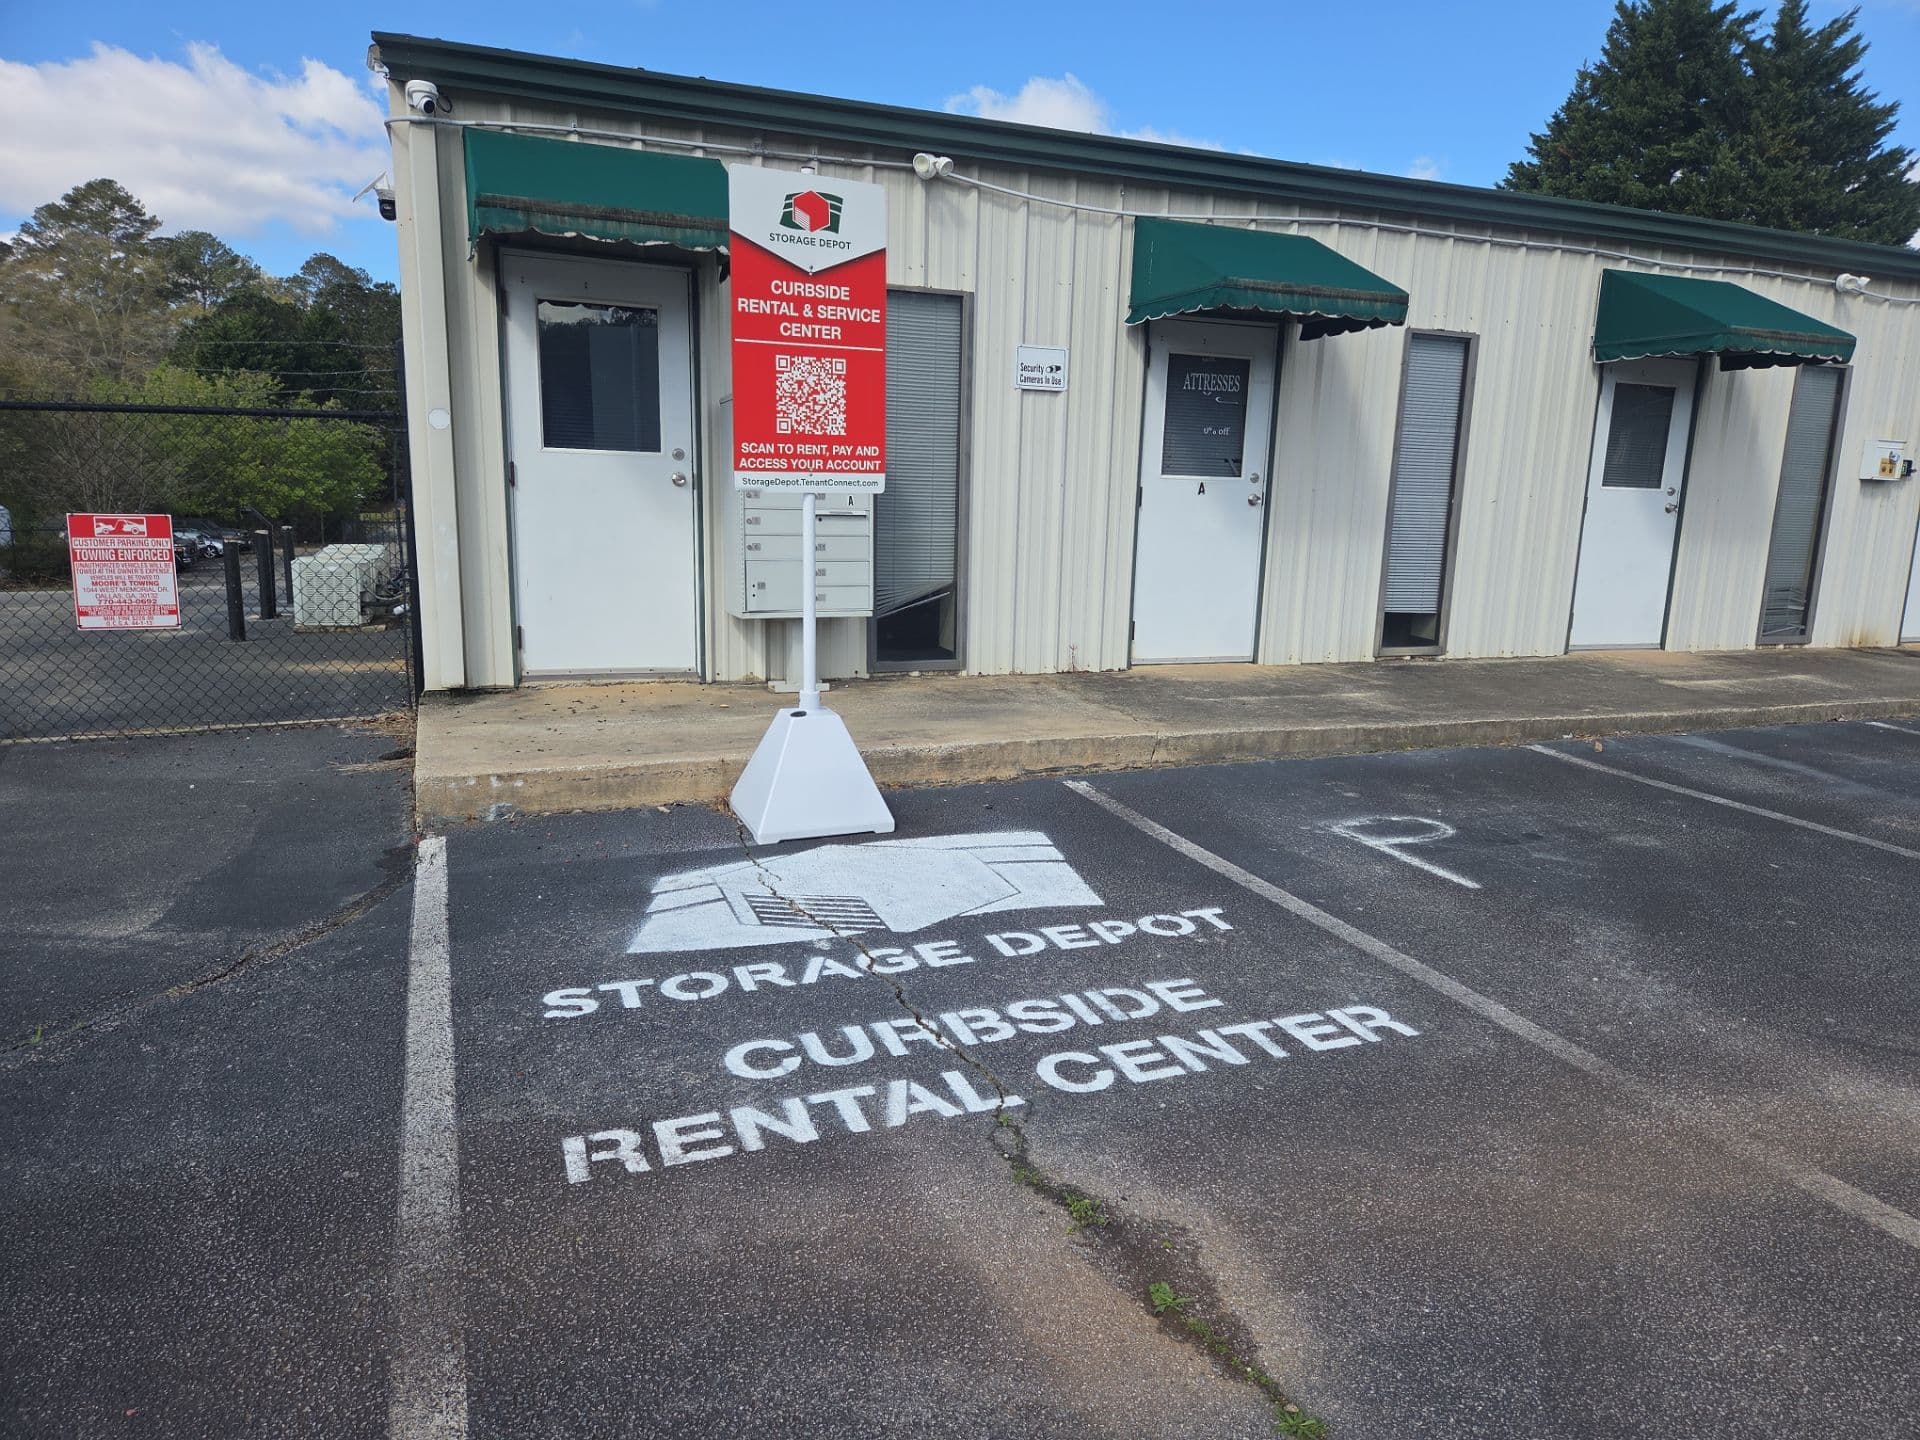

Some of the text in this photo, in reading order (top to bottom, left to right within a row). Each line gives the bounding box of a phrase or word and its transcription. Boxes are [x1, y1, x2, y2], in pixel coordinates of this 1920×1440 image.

[769, 233, 851, 250] STORAGE DEPOT
[771, 280, 850, 300] CURBSIDE
[737, 298, 881, 323] RENTAL & SERVICE
[780, 322, 841, 340] CENTER
[1020, 362, 1044, 375] Security
[1020, 374, 1043, 384] Cameras
[1052, 376, 1061, 385] Use
[741, 443, 880, 457] SCAN TO RENT, PAY AND
[739, 458, 881, 471] ACCESS YOUR ACCOUNT
[742, 478, 879, 488] StorageDepot.TenantConnect.com
[1198, 482, 1205, 495] A
[848, 495, 854, 506] A
[74, 538, 169, 547] CUSTOMER PARKING ONLY
[75, 549, 170, 561] TOWING ENFORCED
[543, 907, 1233, 1020] STORAGE DEPOT
[725, 977, 1223, 1080] CURBSIDE
[562, 1005, 1420, 1185] RENTAL CENTER
